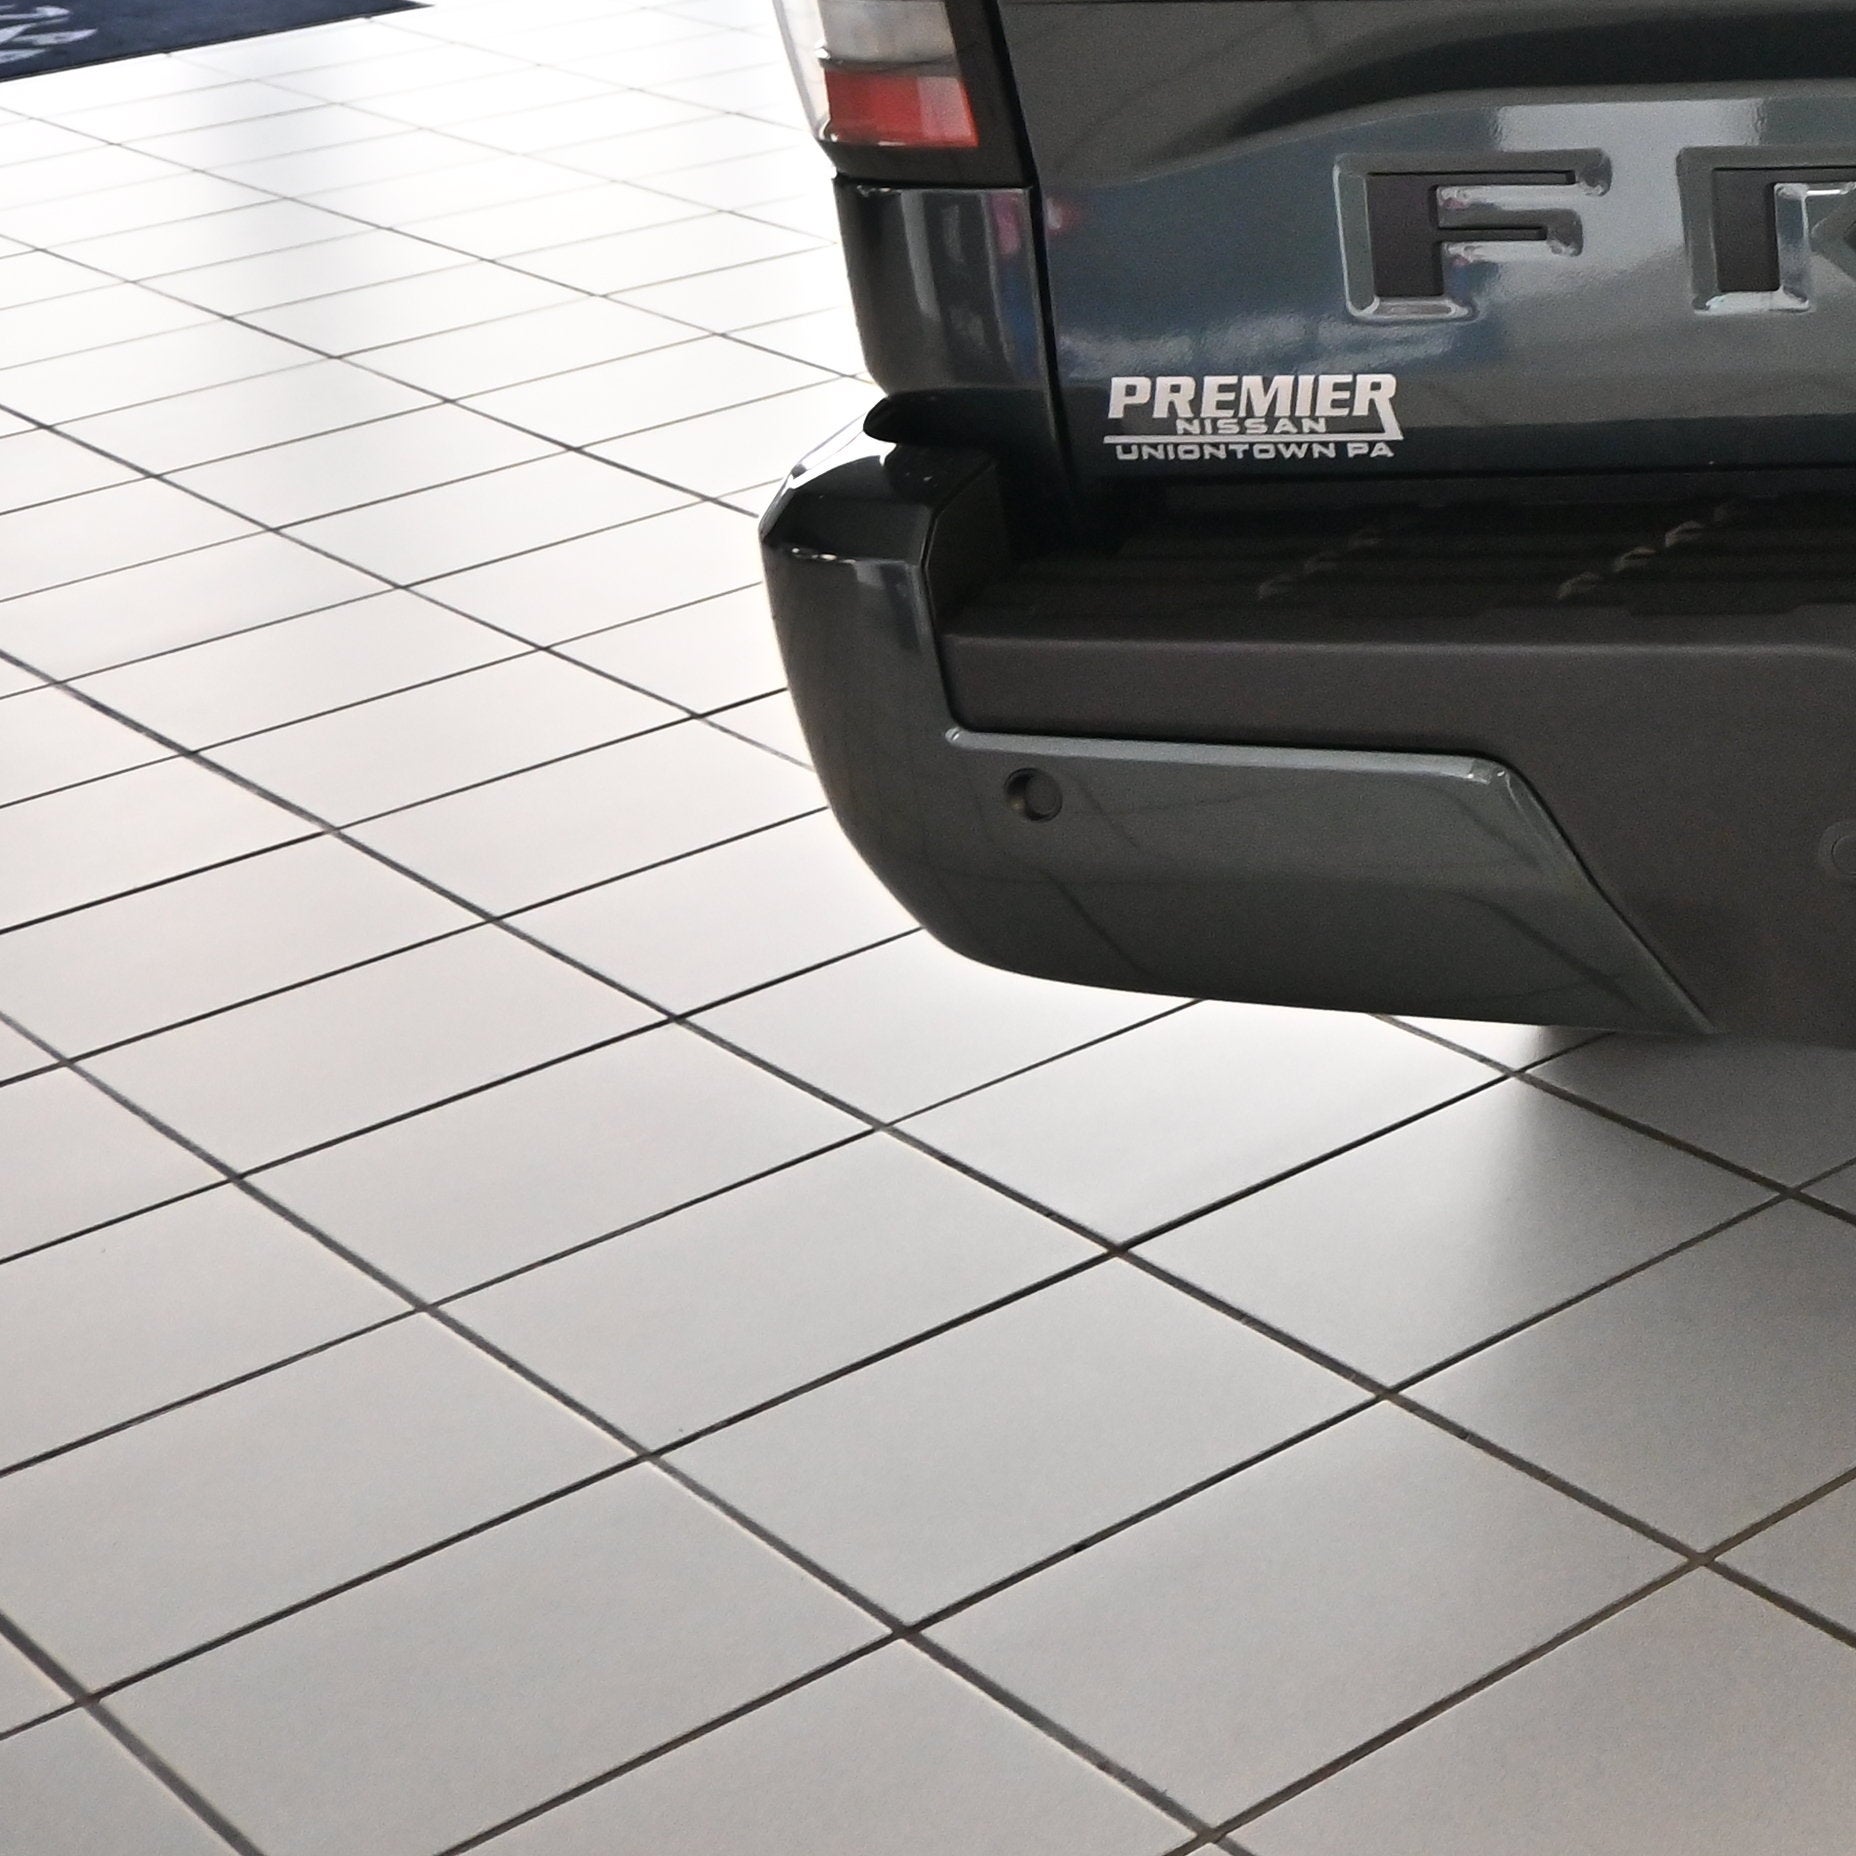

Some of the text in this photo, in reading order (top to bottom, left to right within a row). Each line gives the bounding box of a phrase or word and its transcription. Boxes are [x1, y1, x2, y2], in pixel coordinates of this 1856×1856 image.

[1107, 372, 1401, 428] PREMIER
[1175, 416, 1328, 436] NISSAN
[1115, 441, 1395, 461] UNIONTOWN PA
